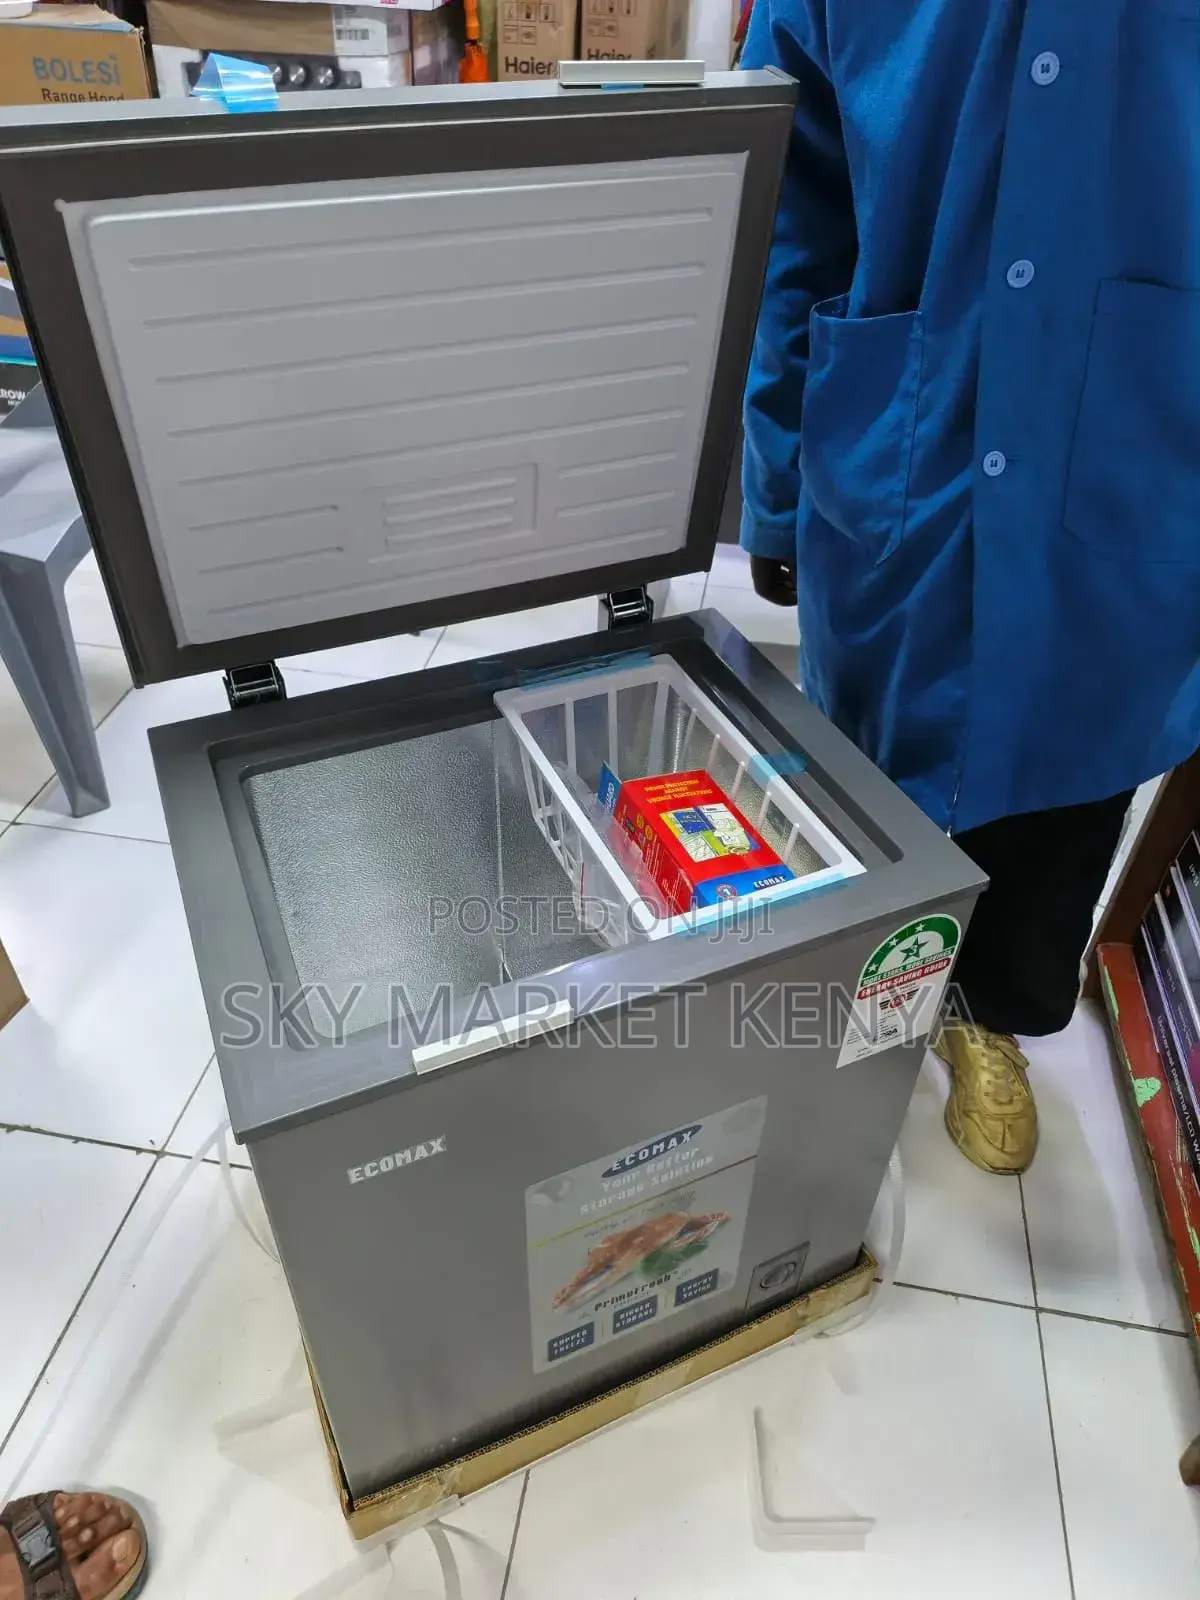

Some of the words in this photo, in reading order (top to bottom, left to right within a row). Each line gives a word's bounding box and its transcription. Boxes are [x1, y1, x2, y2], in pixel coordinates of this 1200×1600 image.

[504, 56, 553, 76] Haier
[753, 875, 786, 888] ECOMAX
[347, 1135, 447, 1185] ECOMAX
[612, 1130, 692, 1172] ECOMAX
